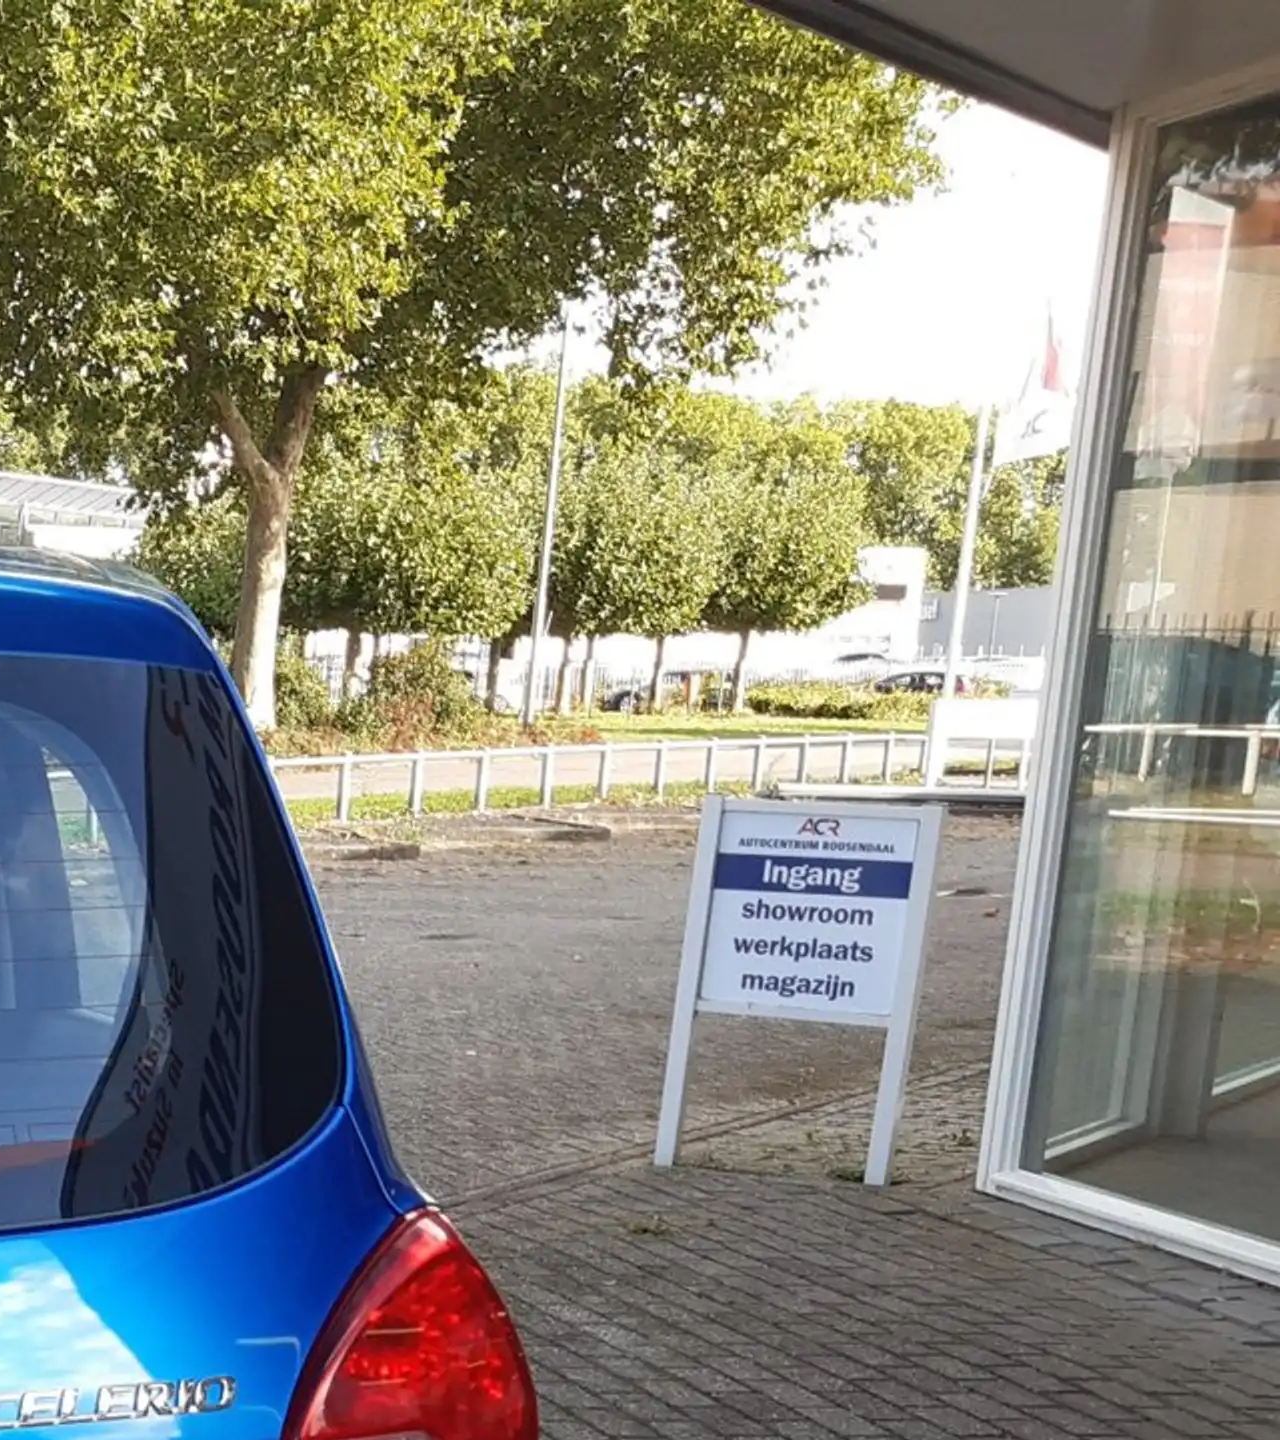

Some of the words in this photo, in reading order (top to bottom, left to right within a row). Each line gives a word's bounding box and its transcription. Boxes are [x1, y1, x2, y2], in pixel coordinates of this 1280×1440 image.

[796, 817, 841, 837] ACR
[738, 837, 820, 851] AUTOCENTRUM
[822, 840, 896, 854] ROOSENDAAL
[762, 859, 863, 893] Ingang
[741, 899, 875, 926] showroom
[733, 936, 874, 963] werkplaats
[740, 971, 856, 1001] magazijn
